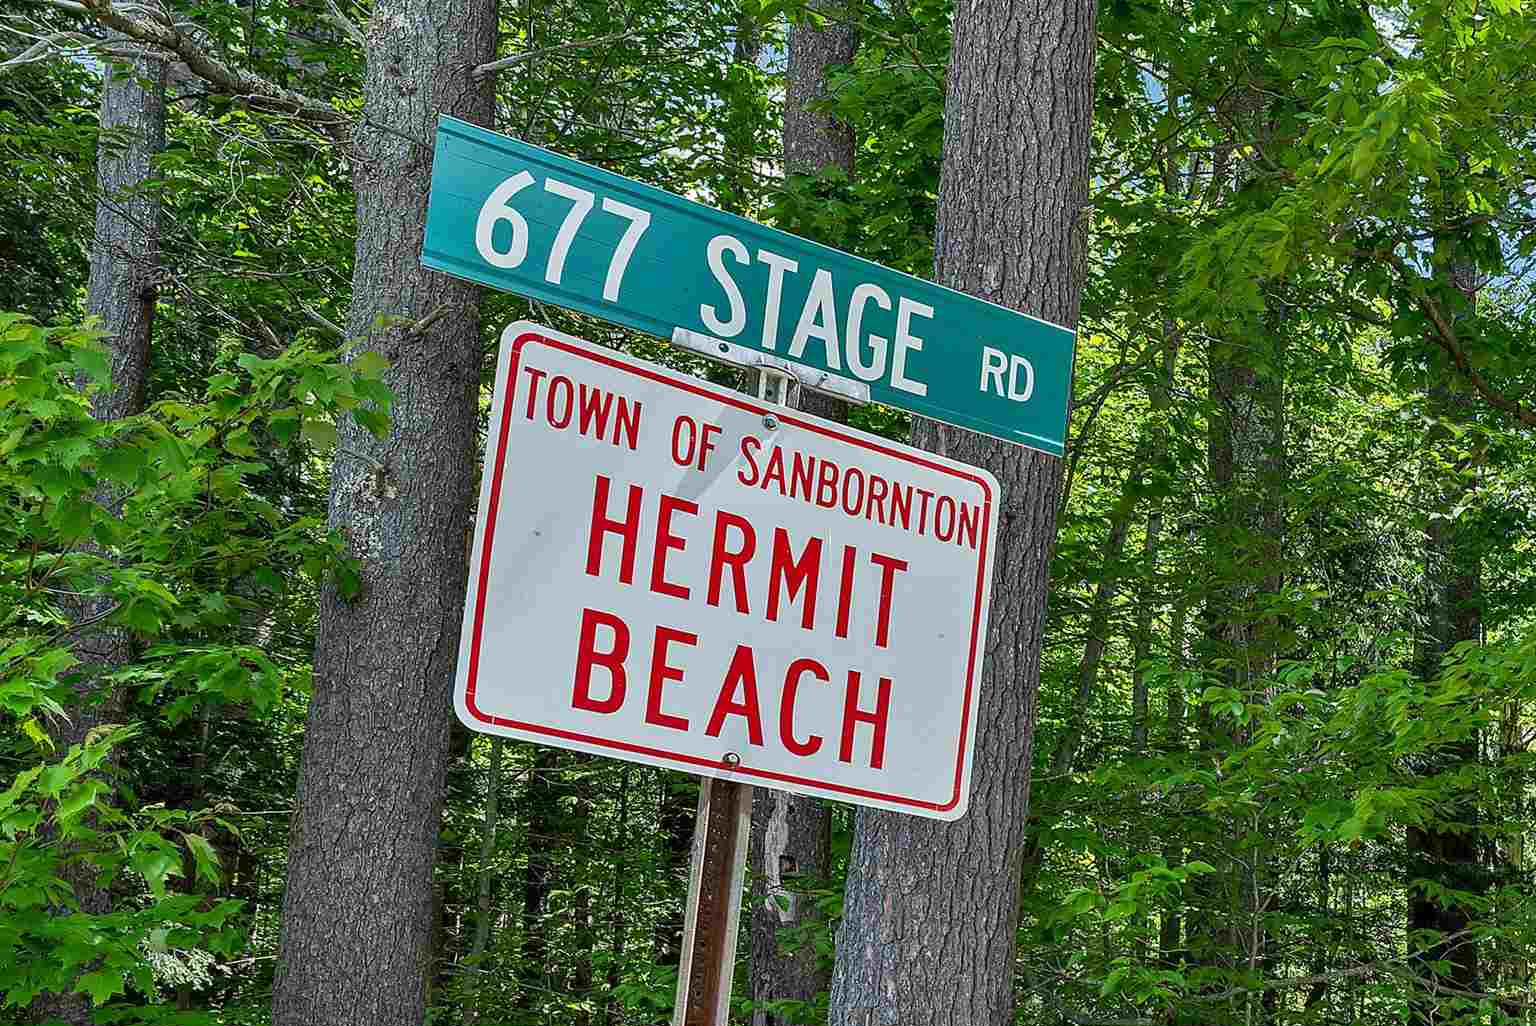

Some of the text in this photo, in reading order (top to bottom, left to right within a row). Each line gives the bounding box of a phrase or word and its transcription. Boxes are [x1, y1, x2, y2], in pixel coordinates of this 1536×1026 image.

[475, 171, 1034, 402] 677 STAGE RD
[522, 366, 980, 549] TOWN OF SANBORNTON
[585, 475, 908, 648] HERMIT
[571, 608, 891, 769] BEACH
